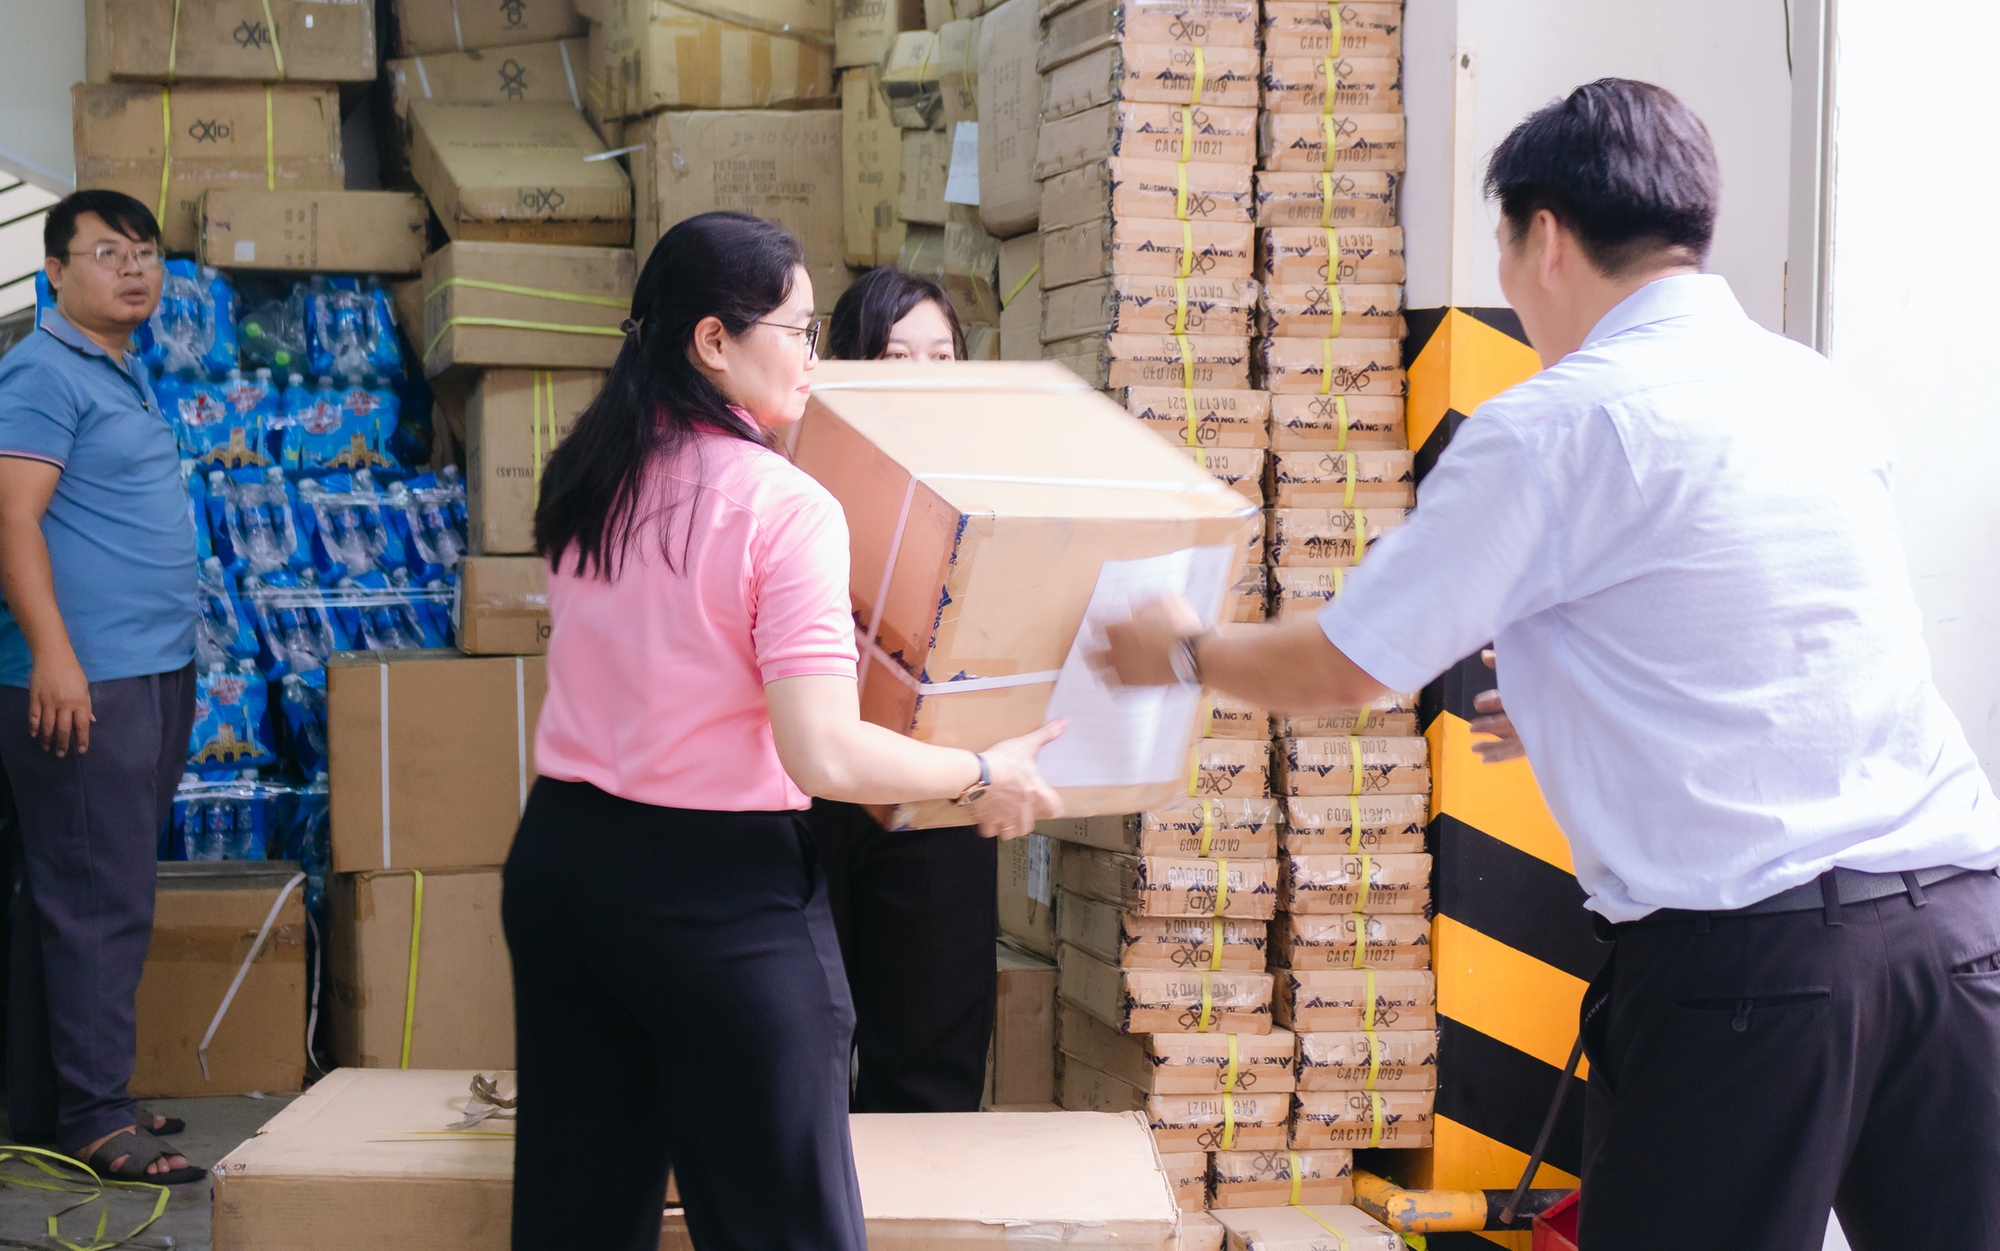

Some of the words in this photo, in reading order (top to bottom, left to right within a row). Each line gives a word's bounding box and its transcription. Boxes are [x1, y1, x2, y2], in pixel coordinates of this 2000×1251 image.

[1301, 36, 1367, 50] CAC11021
[1155, 139, 1222, 155] CAC111021
[1288, 206, 1356, 219] CAC161004
[1308, 235, 1373, 247] CAC17021
[1156, 284, 1223, 299] CAC17021
[1143, 367, 1213, 382] CEU160013
[1323, 741, 1387, 754] EU1600012
[1180, 839, 1240, 852] CAC171009
[1330, 893, 1398, 905] CAC111021
[1327, 950, 1395, 962] CAC111021
[1337, 1068, 1403, 1080] CAC171009
[1330, 1128, 1399, 1140] CAC171021
